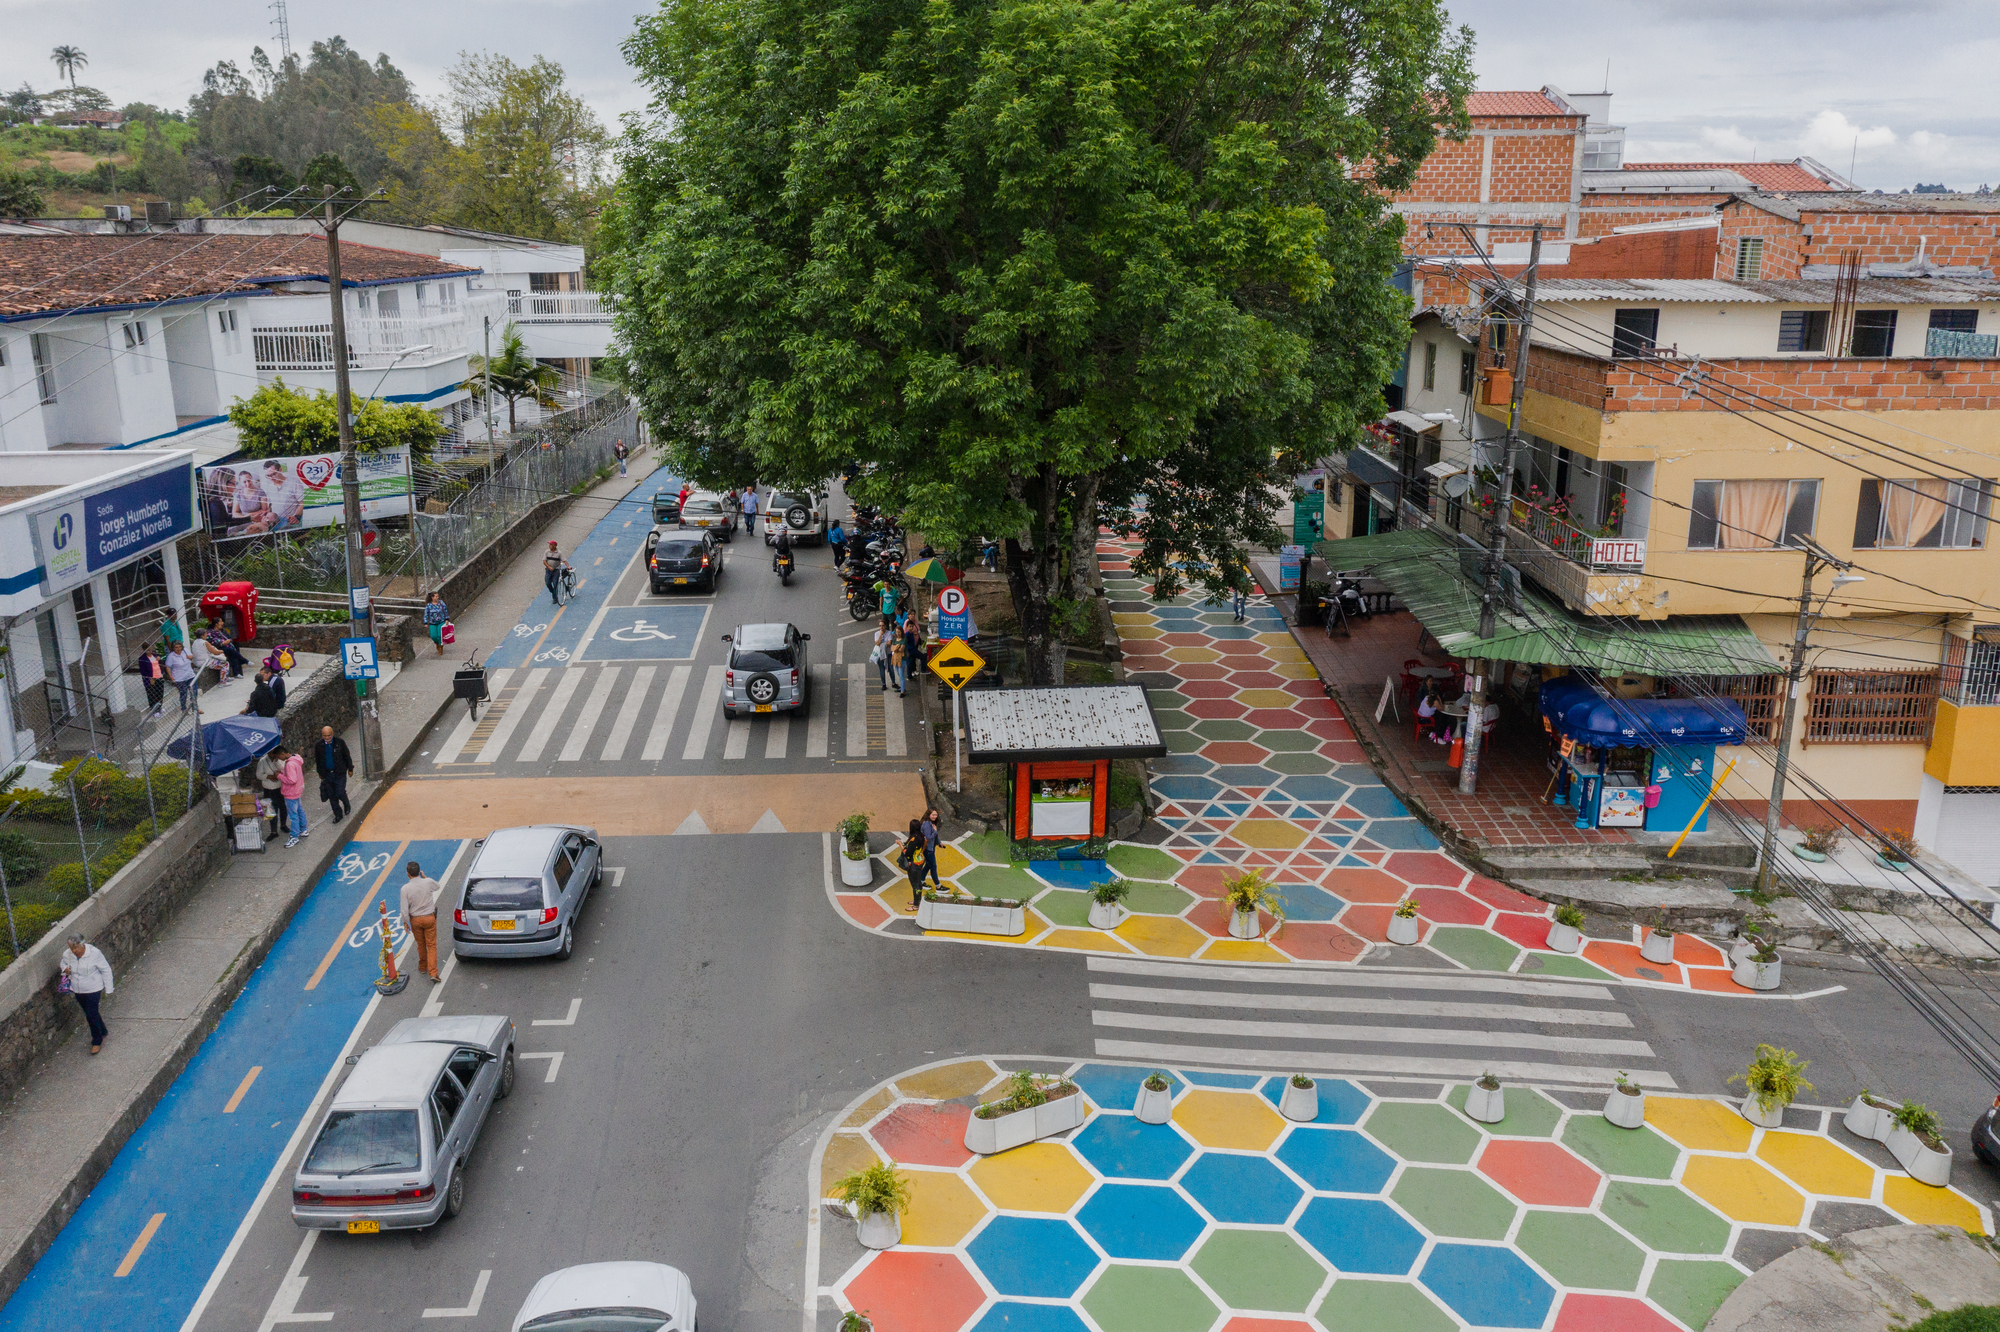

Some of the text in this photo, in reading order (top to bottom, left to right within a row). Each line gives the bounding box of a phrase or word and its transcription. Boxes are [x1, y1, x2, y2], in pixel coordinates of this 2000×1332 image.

[361, 453, 402, 463] HOSPTAL
[306, 466, 323, 475] 231
[97, 503, 114, 517] Sede
[99, 499, 169, 536] Jorge Humberto
[99, 514, 172, 555] González Noreña
[51, 547, 81, 566] HOSPITAL
[1594, 542, 1642, 563] HOTEL
[947, 592, 960, 609] P
[243, 731, 266, 746] tigo
[1622, 728, 1636, 737] tigo
[1671, 727, 1685, 736] tigo
